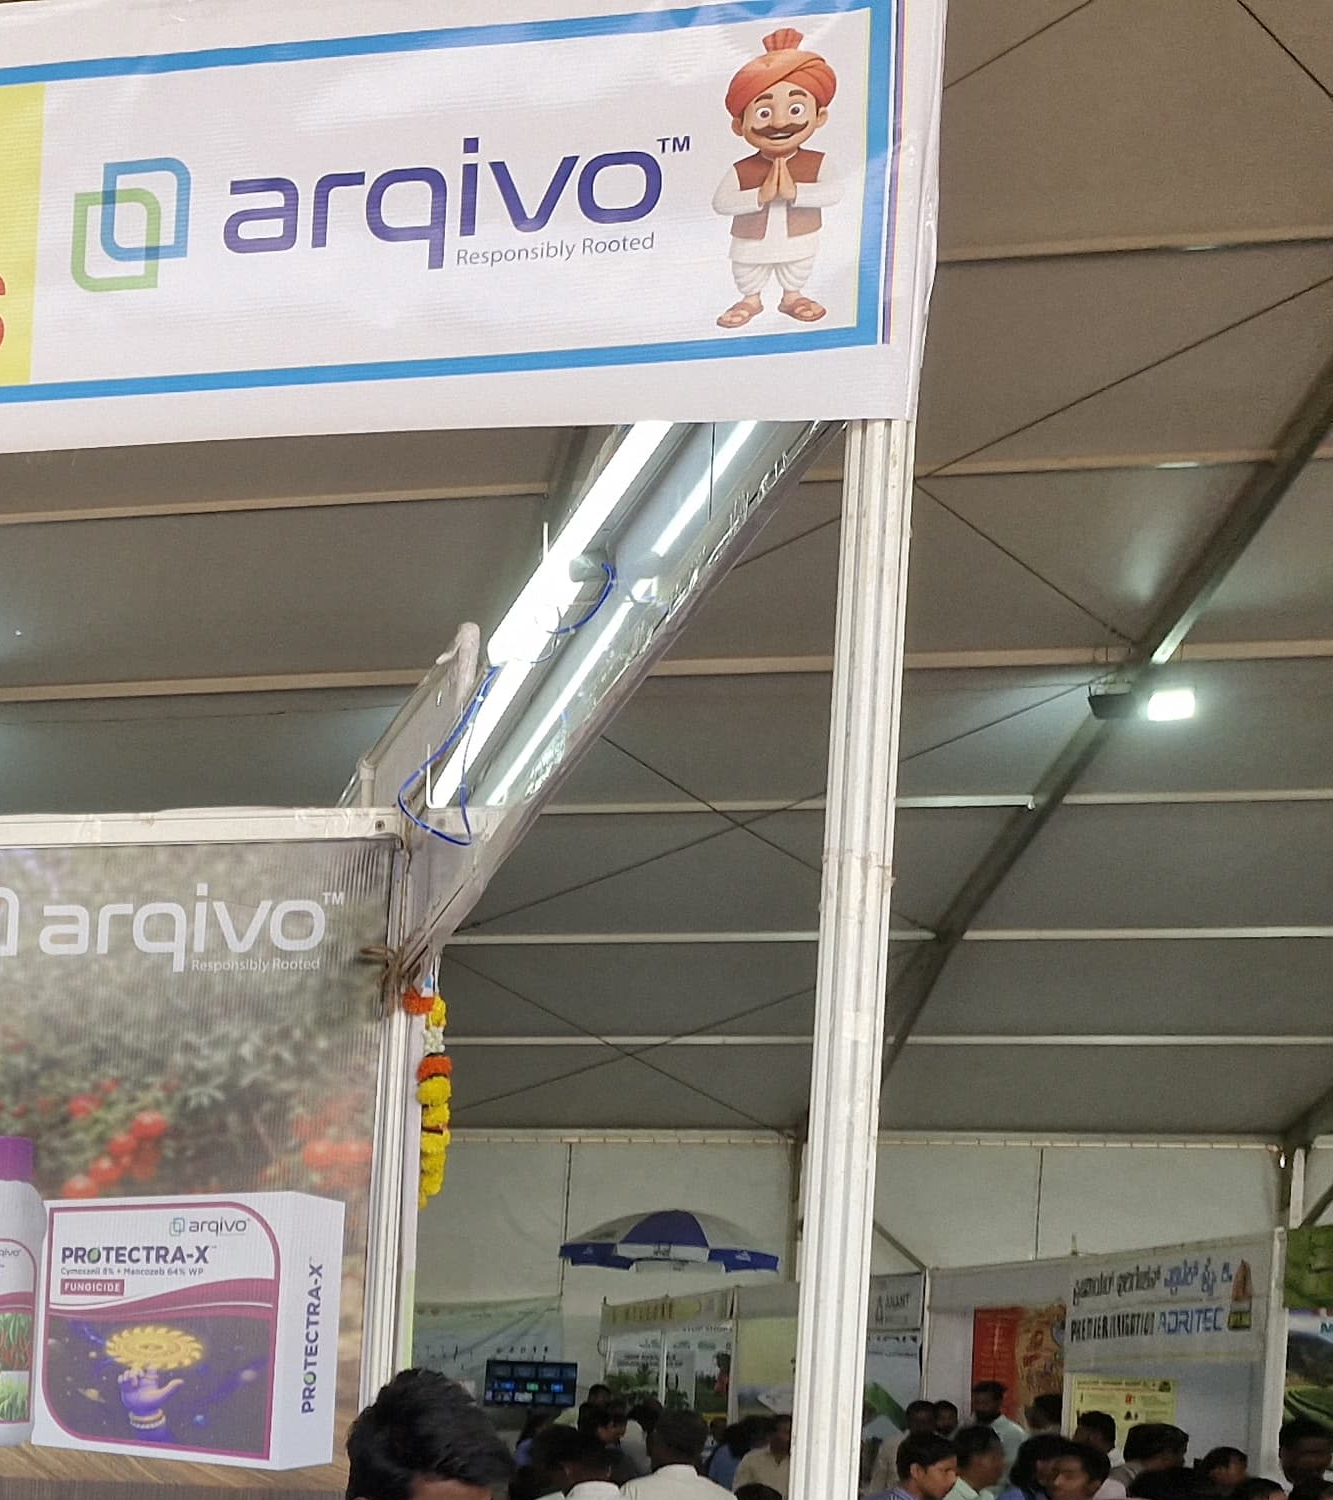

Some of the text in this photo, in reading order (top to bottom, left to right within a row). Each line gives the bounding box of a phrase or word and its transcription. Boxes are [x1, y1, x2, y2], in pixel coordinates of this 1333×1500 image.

[222, 137, 663, 270] arqivo
[456, 233, 655, 268] Responsibly Rooted
[39, 883, 325, 972] arqivo
[192, 957, 320, 973] Responsibly Rooted
[189, 1218, 247, 1238] arqivo
[61, 1245, 209, 1265] PROTECTRA-X
[65, 1282, 122, 1293] FUNGICIDE
[301, 1264, 325, 1414] PROTECTRA-X
